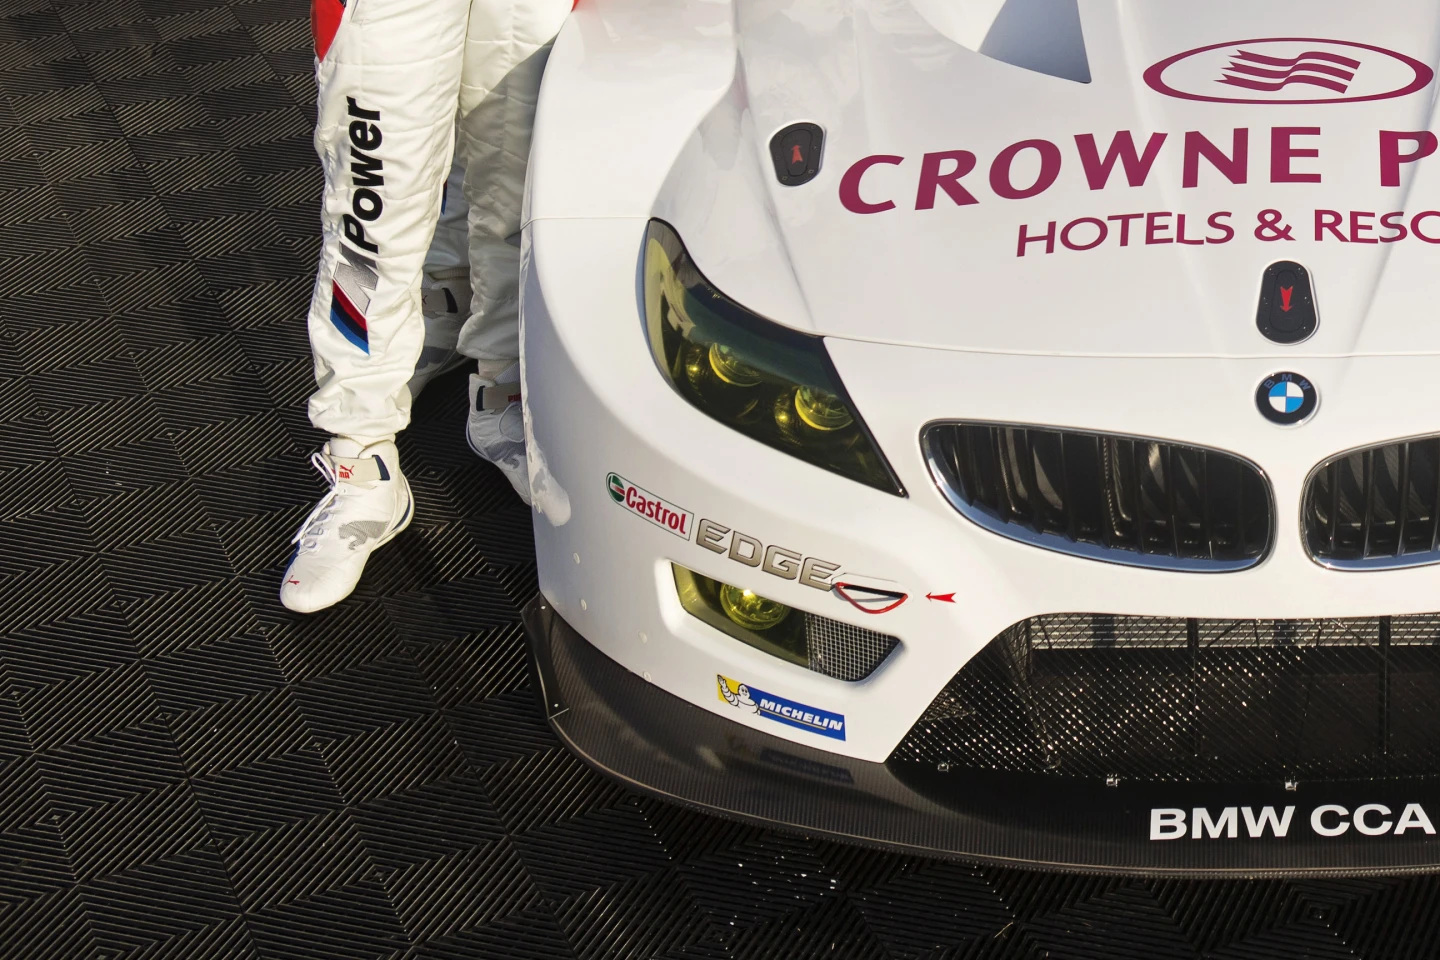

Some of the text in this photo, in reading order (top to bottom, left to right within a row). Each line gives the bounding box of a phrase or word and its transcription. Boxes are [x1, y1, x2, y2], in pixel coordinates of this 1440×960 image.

[341, 95, 386, 255] Power
[837, 126, 1322, 215] CROWNE
[1015, 211, 1235, 258] HOTELS
[1255, 209, 1294, 242] &
[1264, 373, 1311, 391] BMW
[625, 486, 841, 592] Castrol EDGE
[759, 698, 843, 731] MICHELIN
[1149, 802, 1437, 840] BMW CCA
